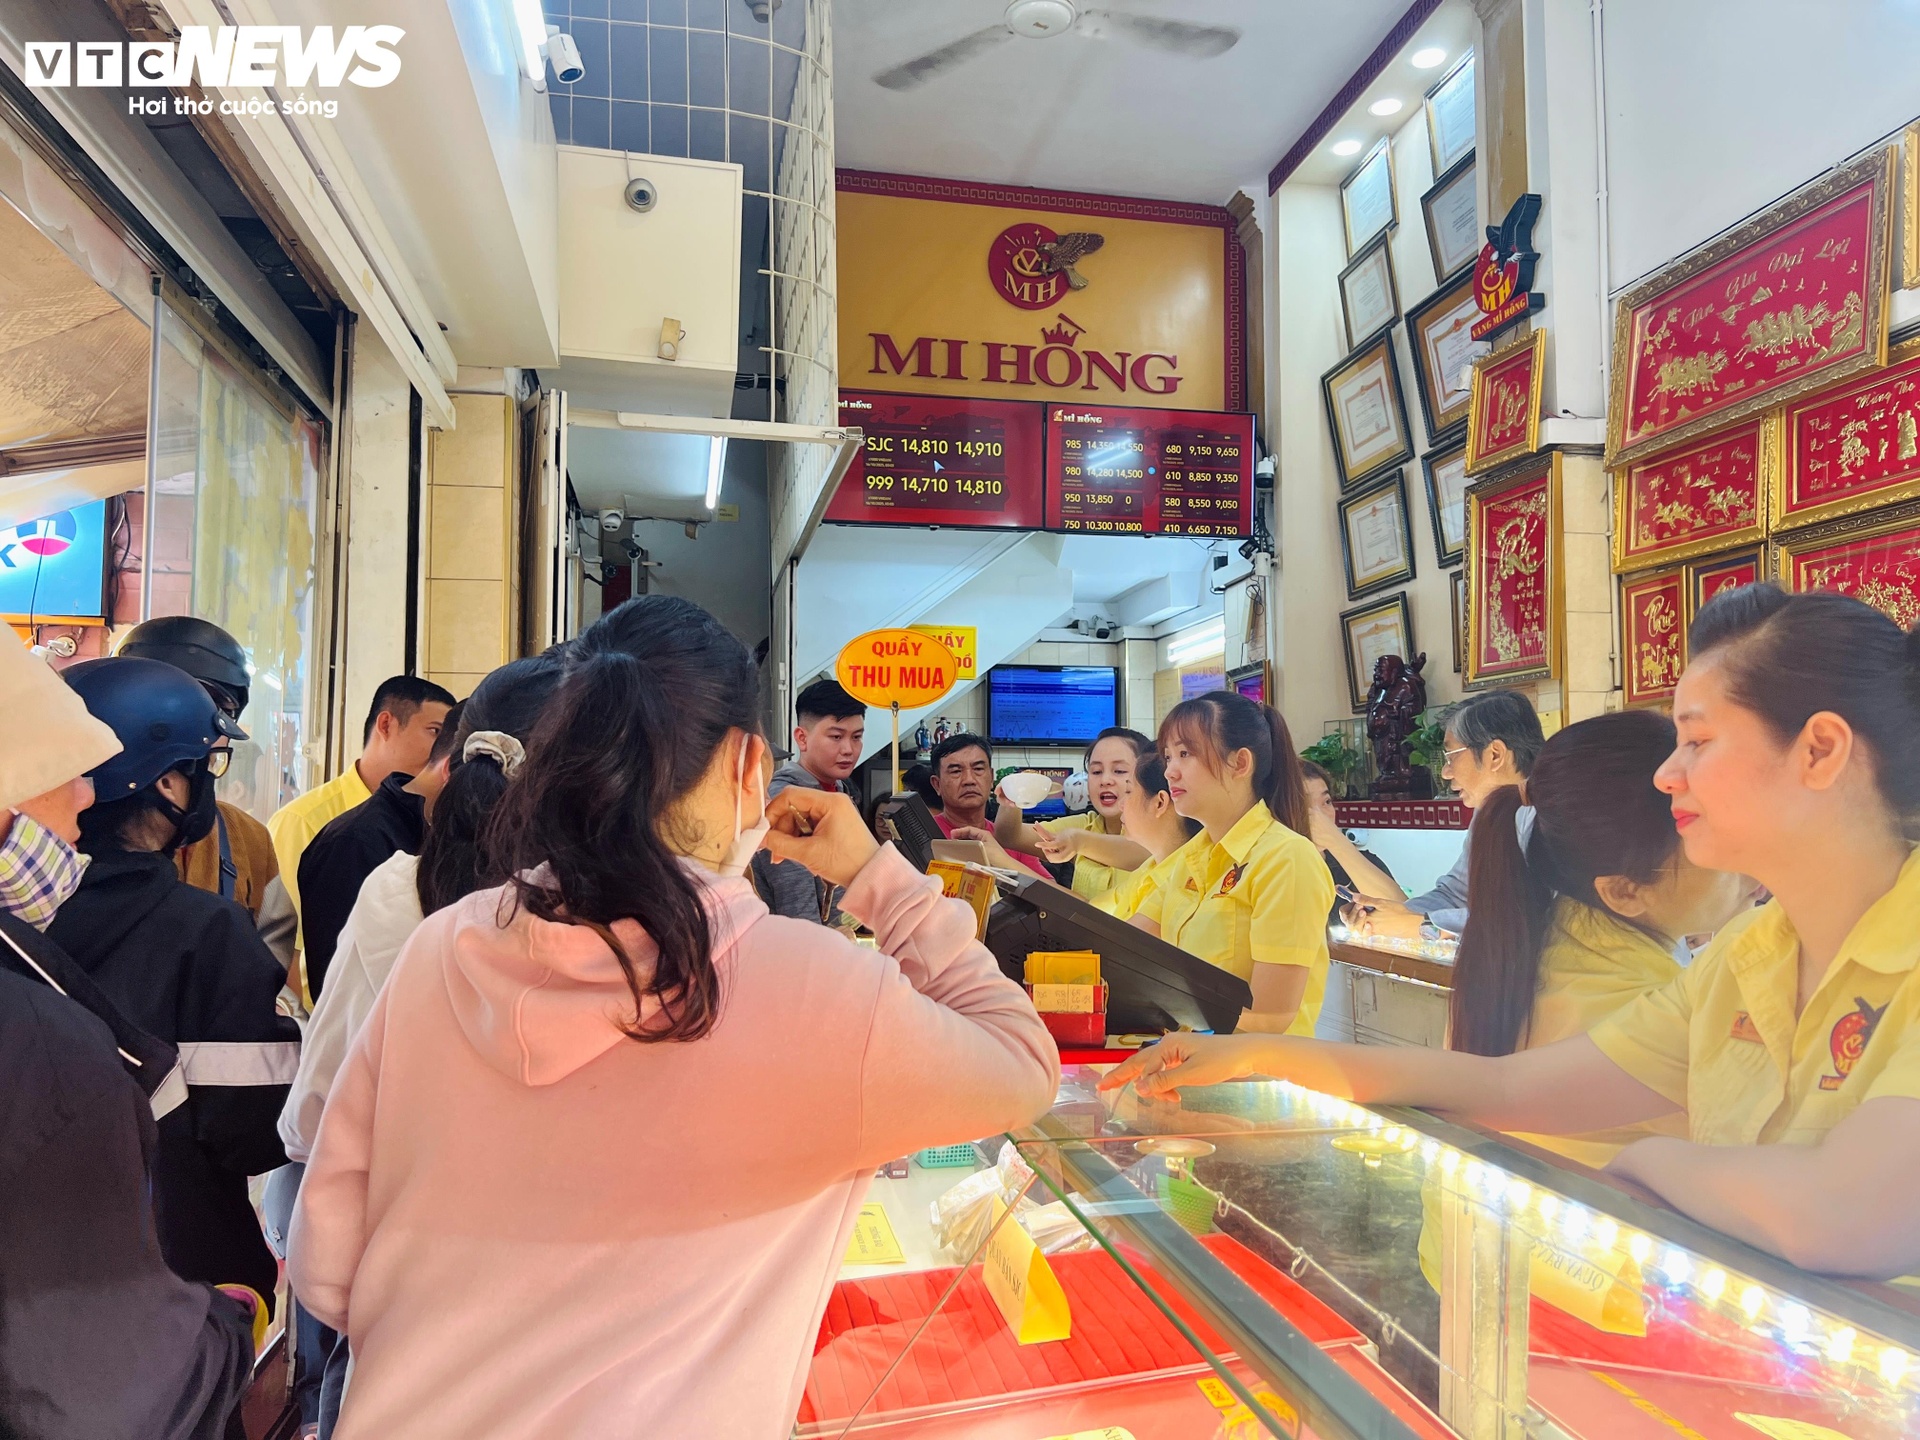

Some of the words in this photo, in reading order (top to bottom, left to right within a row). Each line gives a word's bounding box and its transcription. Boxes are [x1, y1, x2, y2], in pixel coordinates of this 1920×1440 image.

[1768, 247, 1805, 274] Đại
[1813, 237, 1851, 263] Lợi
[1003, 267, 1059, 304] MH
[1480, 274, 1511, 311] MH
[868, 332, 969, 380] MI
[981, 312, 1184, 394] HỒNG
[867, 437, 893, 452] SJC
[901, 438, 948, 456] 14,810
[955, 441, 1002, 458] 14,910
[1065, 440, 1082, 449] 985
[1165, 444, 1182, 455] 680
[1189, 446, 1212, 456] 9,150
[1216, 447, 1239, 458] 9,650
[1065, 467, 1082, 476] 980
[1087, 467, 1114, 478] 14,280
[1116, 469, 1143, 479] 14,500
[1165, 471, 1182, 481] 610
[1188, 472, 1212, 482] 8,850
[1215, 473, 1239, 484] 9,350
[866, 475, 894, 490] 999
[901, 476, 948, 494] 14,710
[955, 479, 1002, 496] 14,810
[1064, 493, 1081, 503] 950
[1086, 494, 1114, 504] 13,850
[1125, 496, 1132, 505] 0
[1164, 497, 1181, 507] 580
[1188, 498, 1211, 509] 8,550
[1215, 500, 1238, 510] 9,050
[1064, 520, 1081, 529] 750
[1164, 524, 1181, 533] 410
[872, 636, 922, 658] QUẦY
[849, 665, 891, 688] THU
[900, 666, 945, 689] MUA
